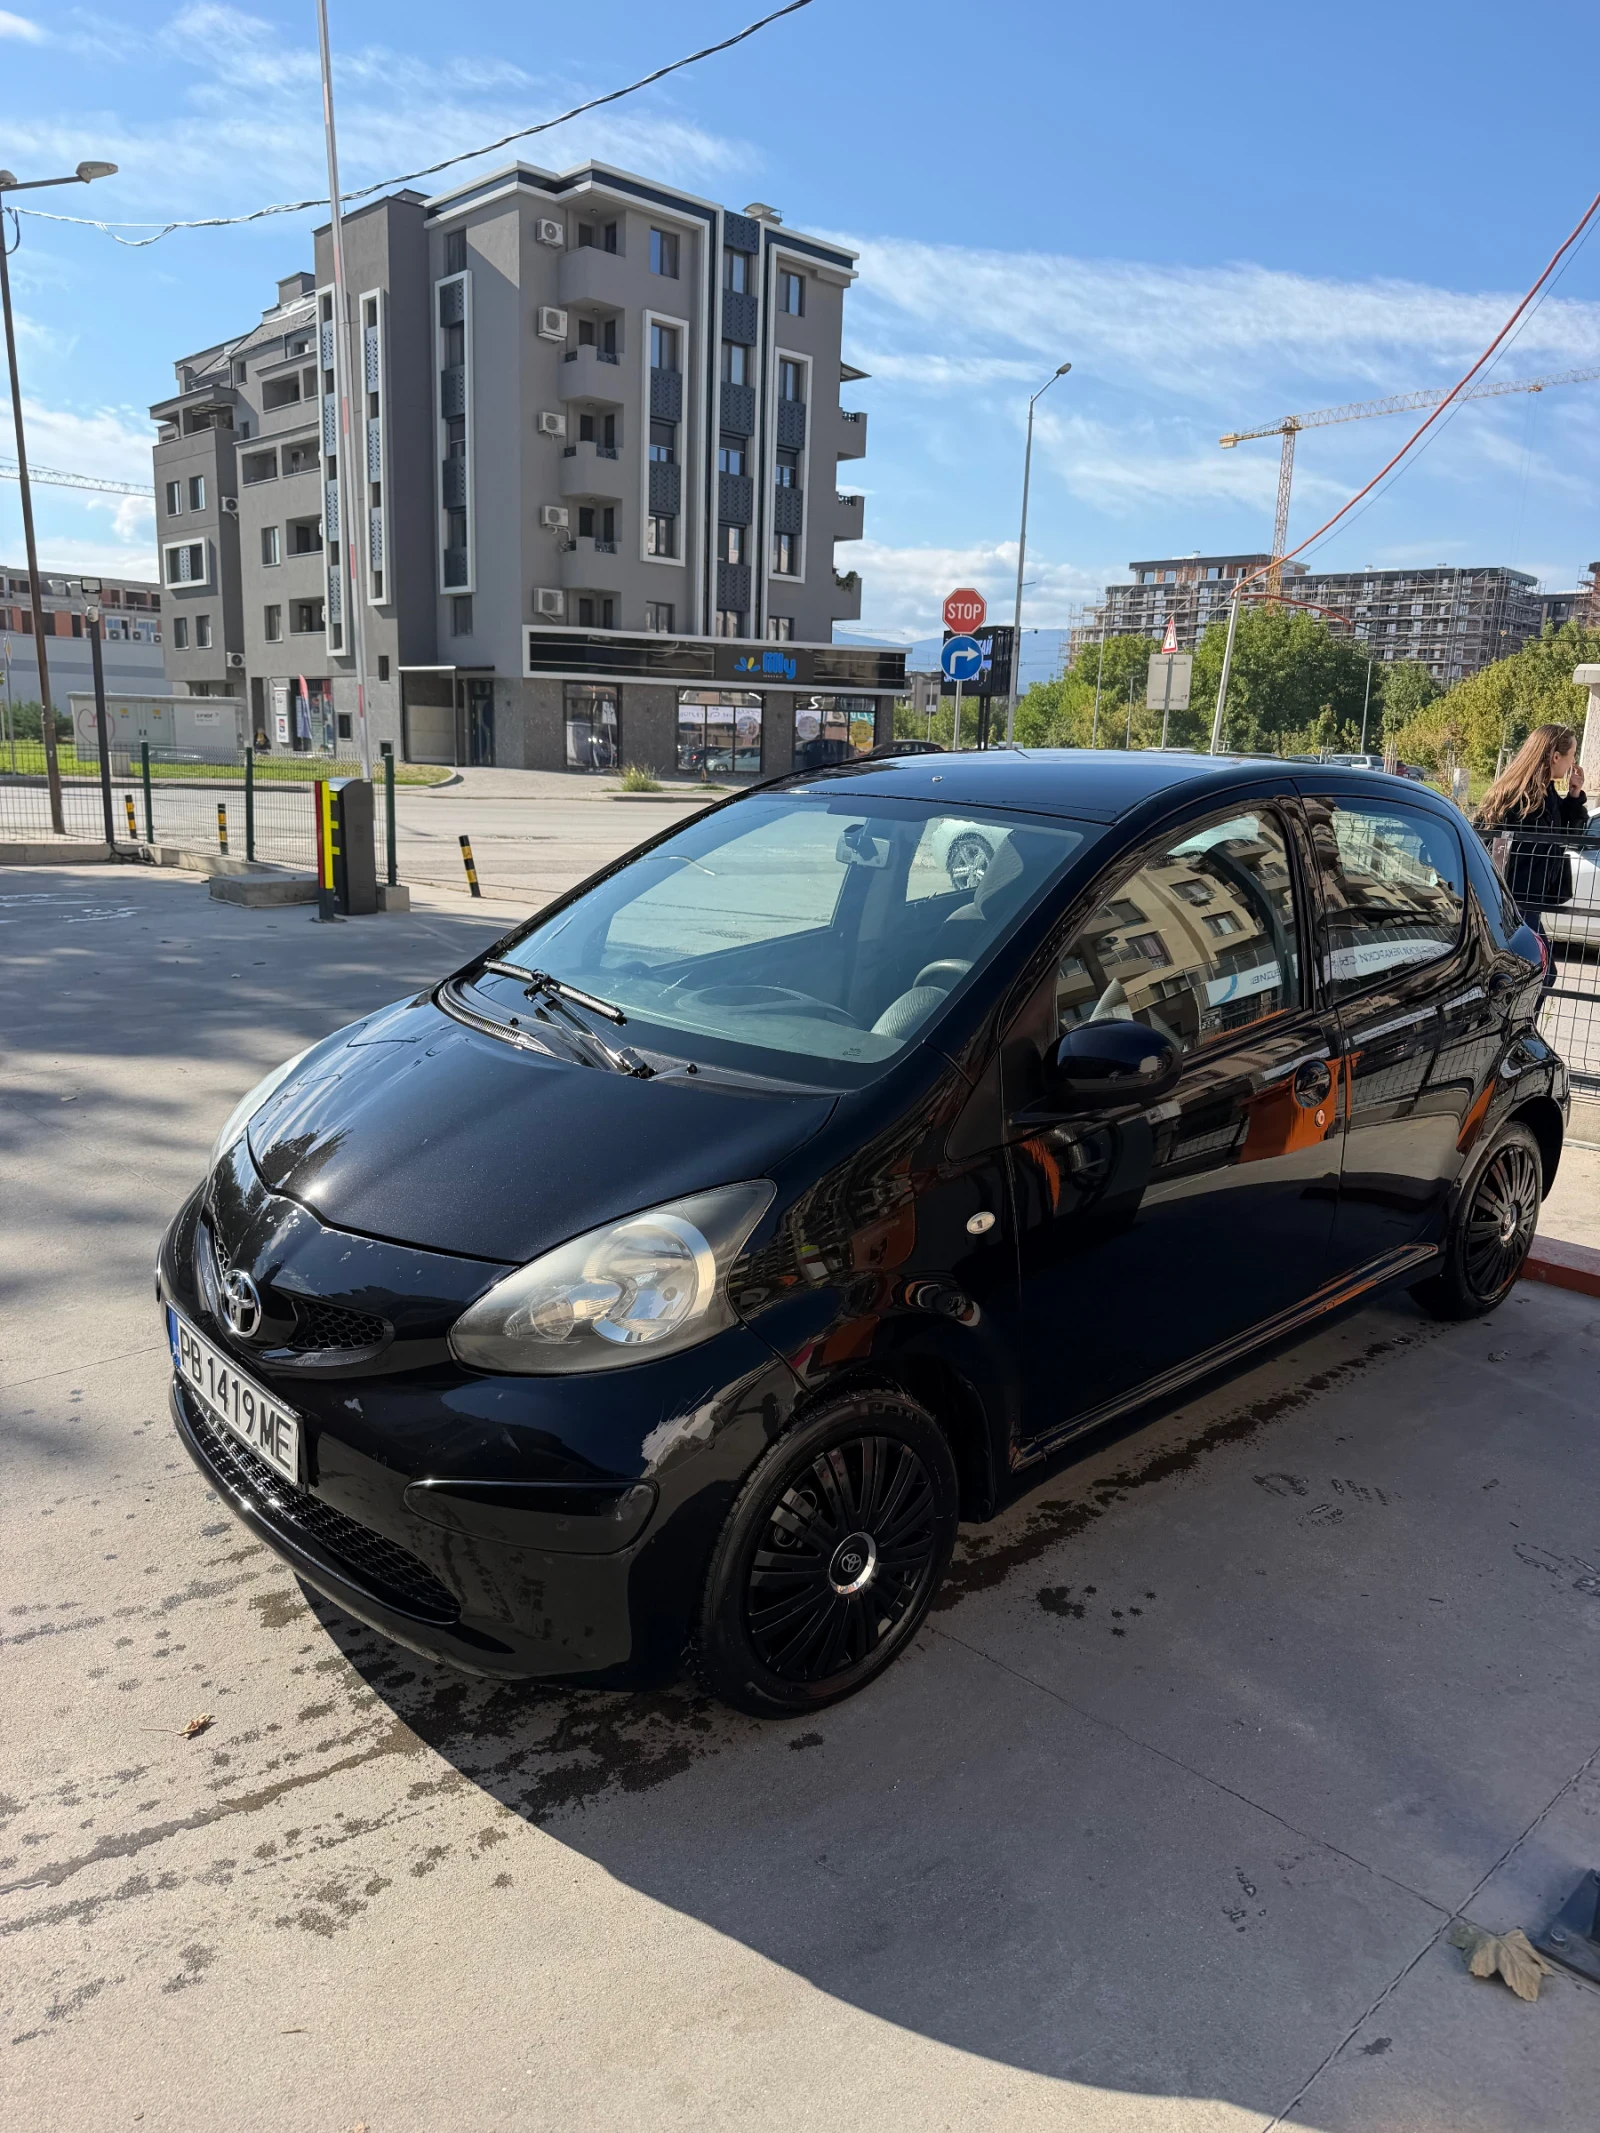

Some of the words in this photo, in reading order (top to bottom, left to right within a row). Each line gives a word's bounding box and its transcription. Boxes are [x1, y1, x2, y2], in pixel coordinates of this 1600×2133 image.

[947, 603, 982, 620] STOP
[762, 651, 796, 680] lilly
[180, 1325, 202, 1384] PB
[207, 1357, 255, 1435] 1419
[260, 1401, 292, 1472] ME
